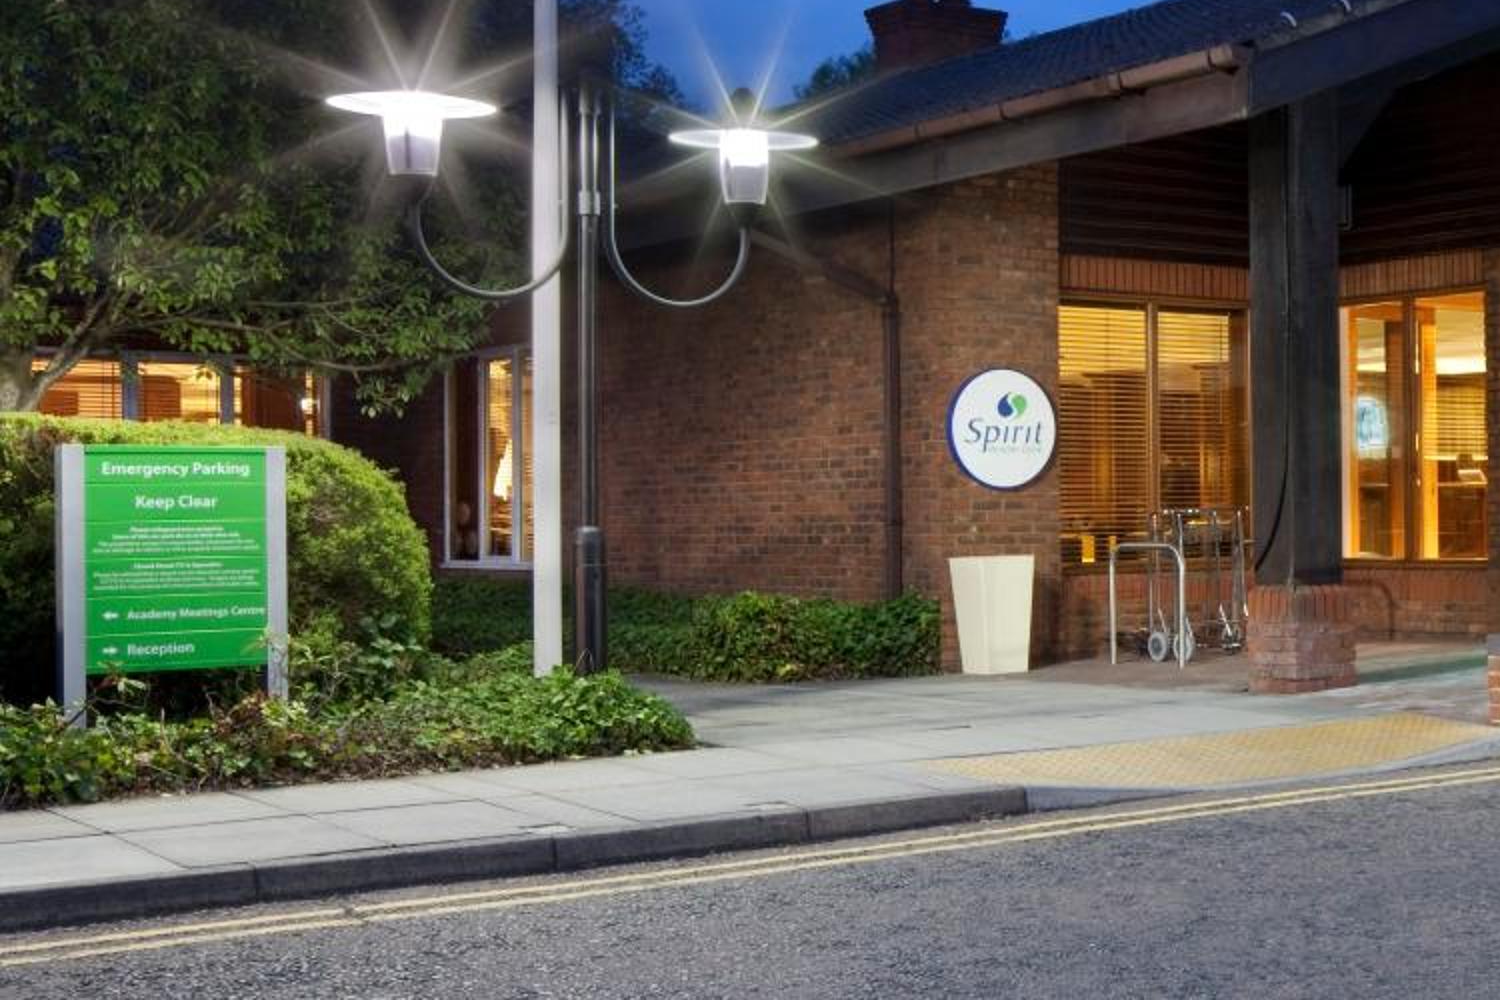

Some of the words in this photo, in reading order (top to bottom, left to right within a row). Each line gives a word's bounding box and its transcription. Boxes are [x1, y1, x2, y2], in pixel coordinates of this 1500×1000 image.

[964, 416, 1044, 453] Spirit
[101, 461, 189, 478] Emergency
[192, 461, 249, 478] Parking
[134, 495, 175, 511] Keep
[178, 494, 218, 508] Clear
[127, 608, 177, 621] Academy
[179, 606, 229, 619] Meetings
[231, 605, 266, 616] Centre
[127, 643, 195, 657] Reception
